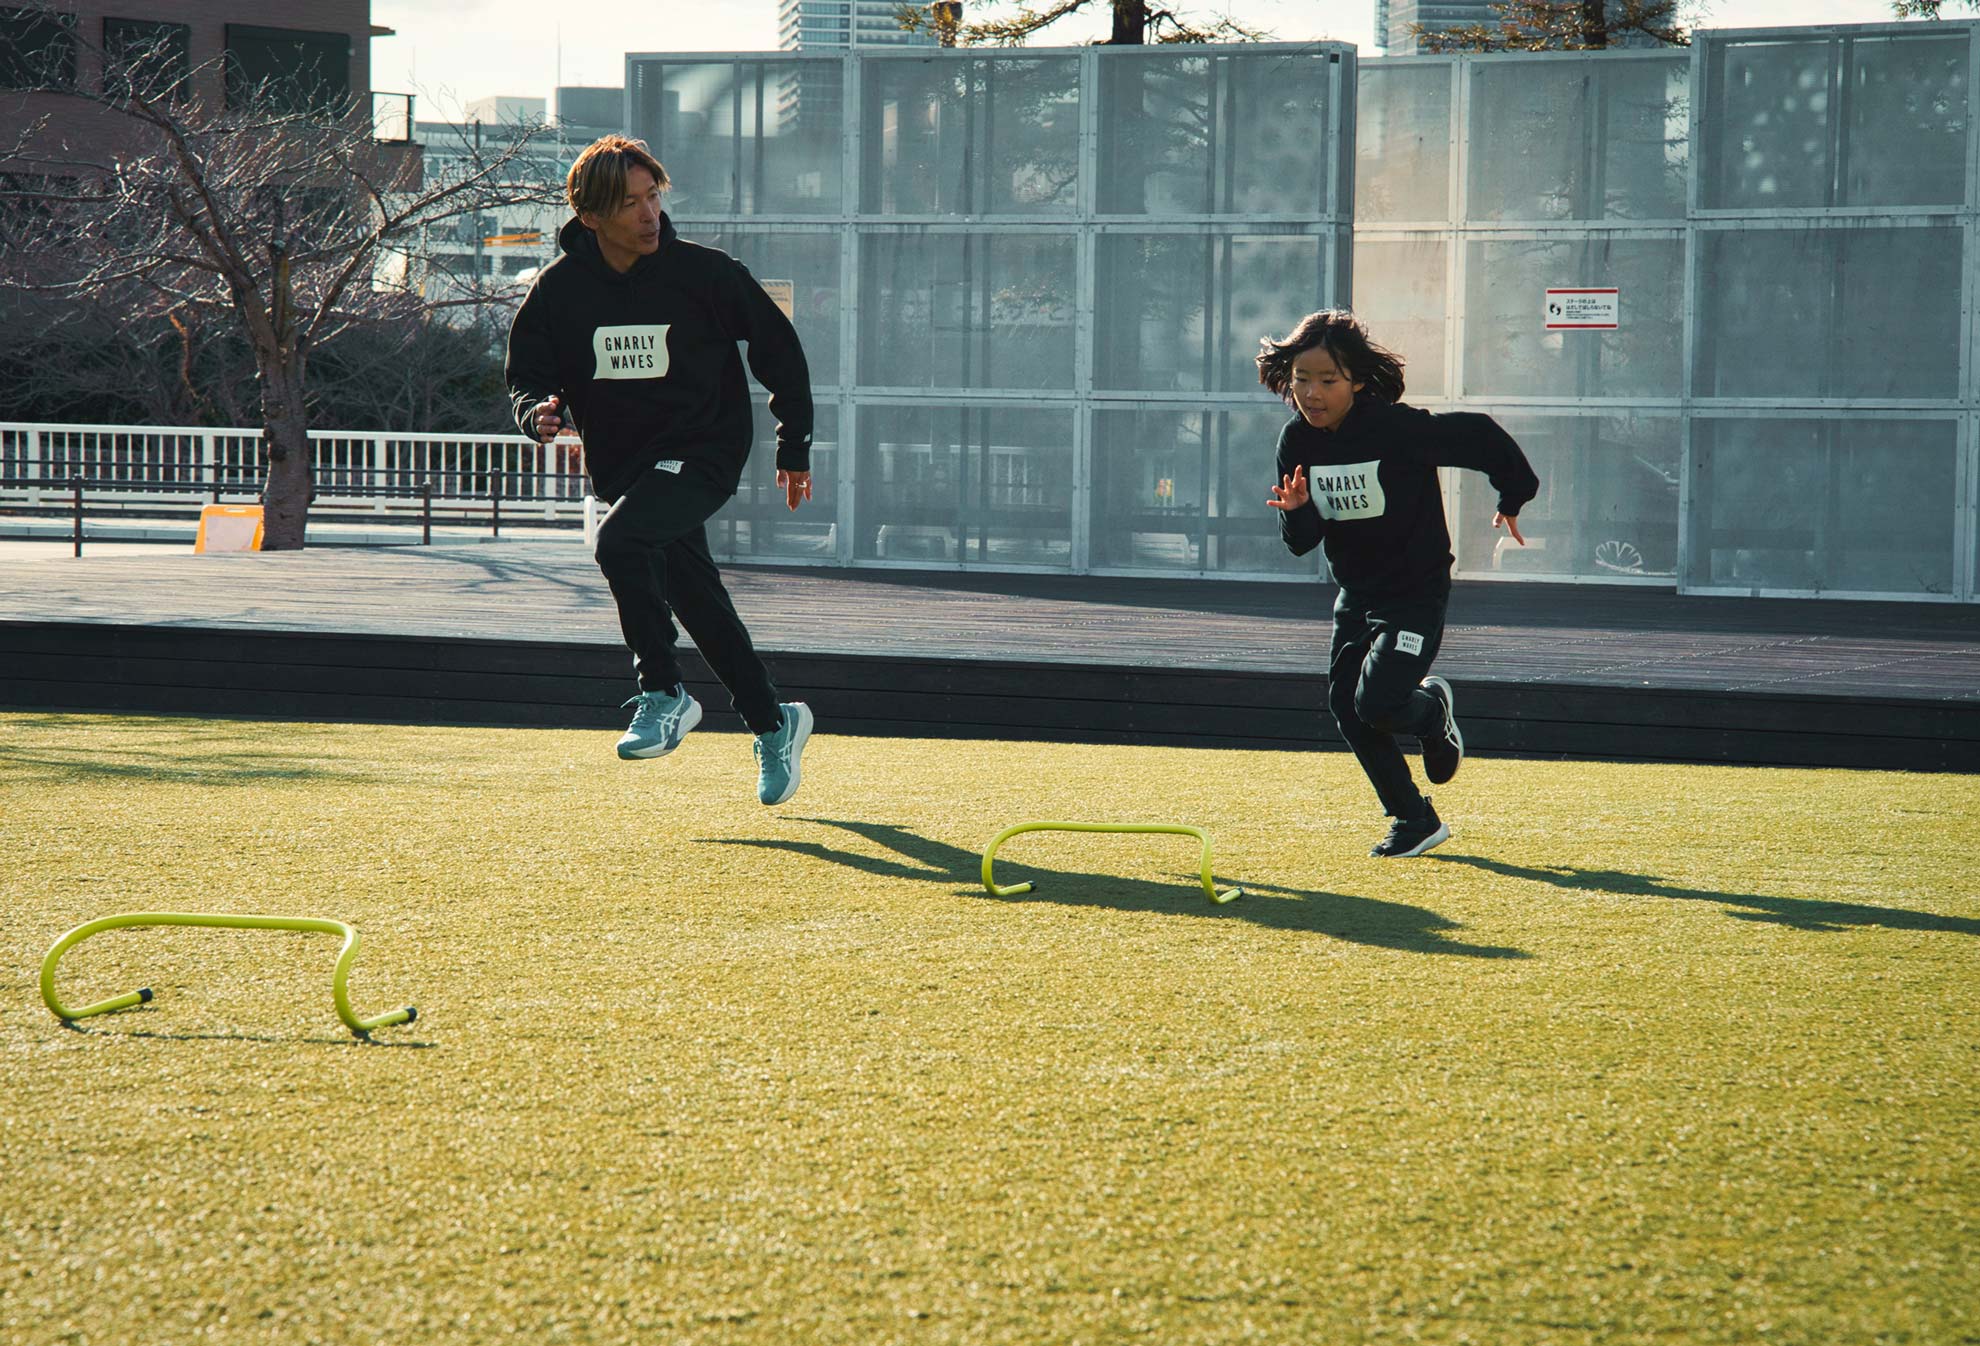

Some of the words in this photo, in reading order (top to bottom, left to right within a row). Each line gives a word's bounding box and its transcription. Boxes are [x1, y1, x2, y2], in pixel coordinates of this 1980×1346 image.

[605, 335, 655, 351] GNARLY
[610, 354, 654, 369] WAVES
[1317, 474, 1366, 492] GNARLY
